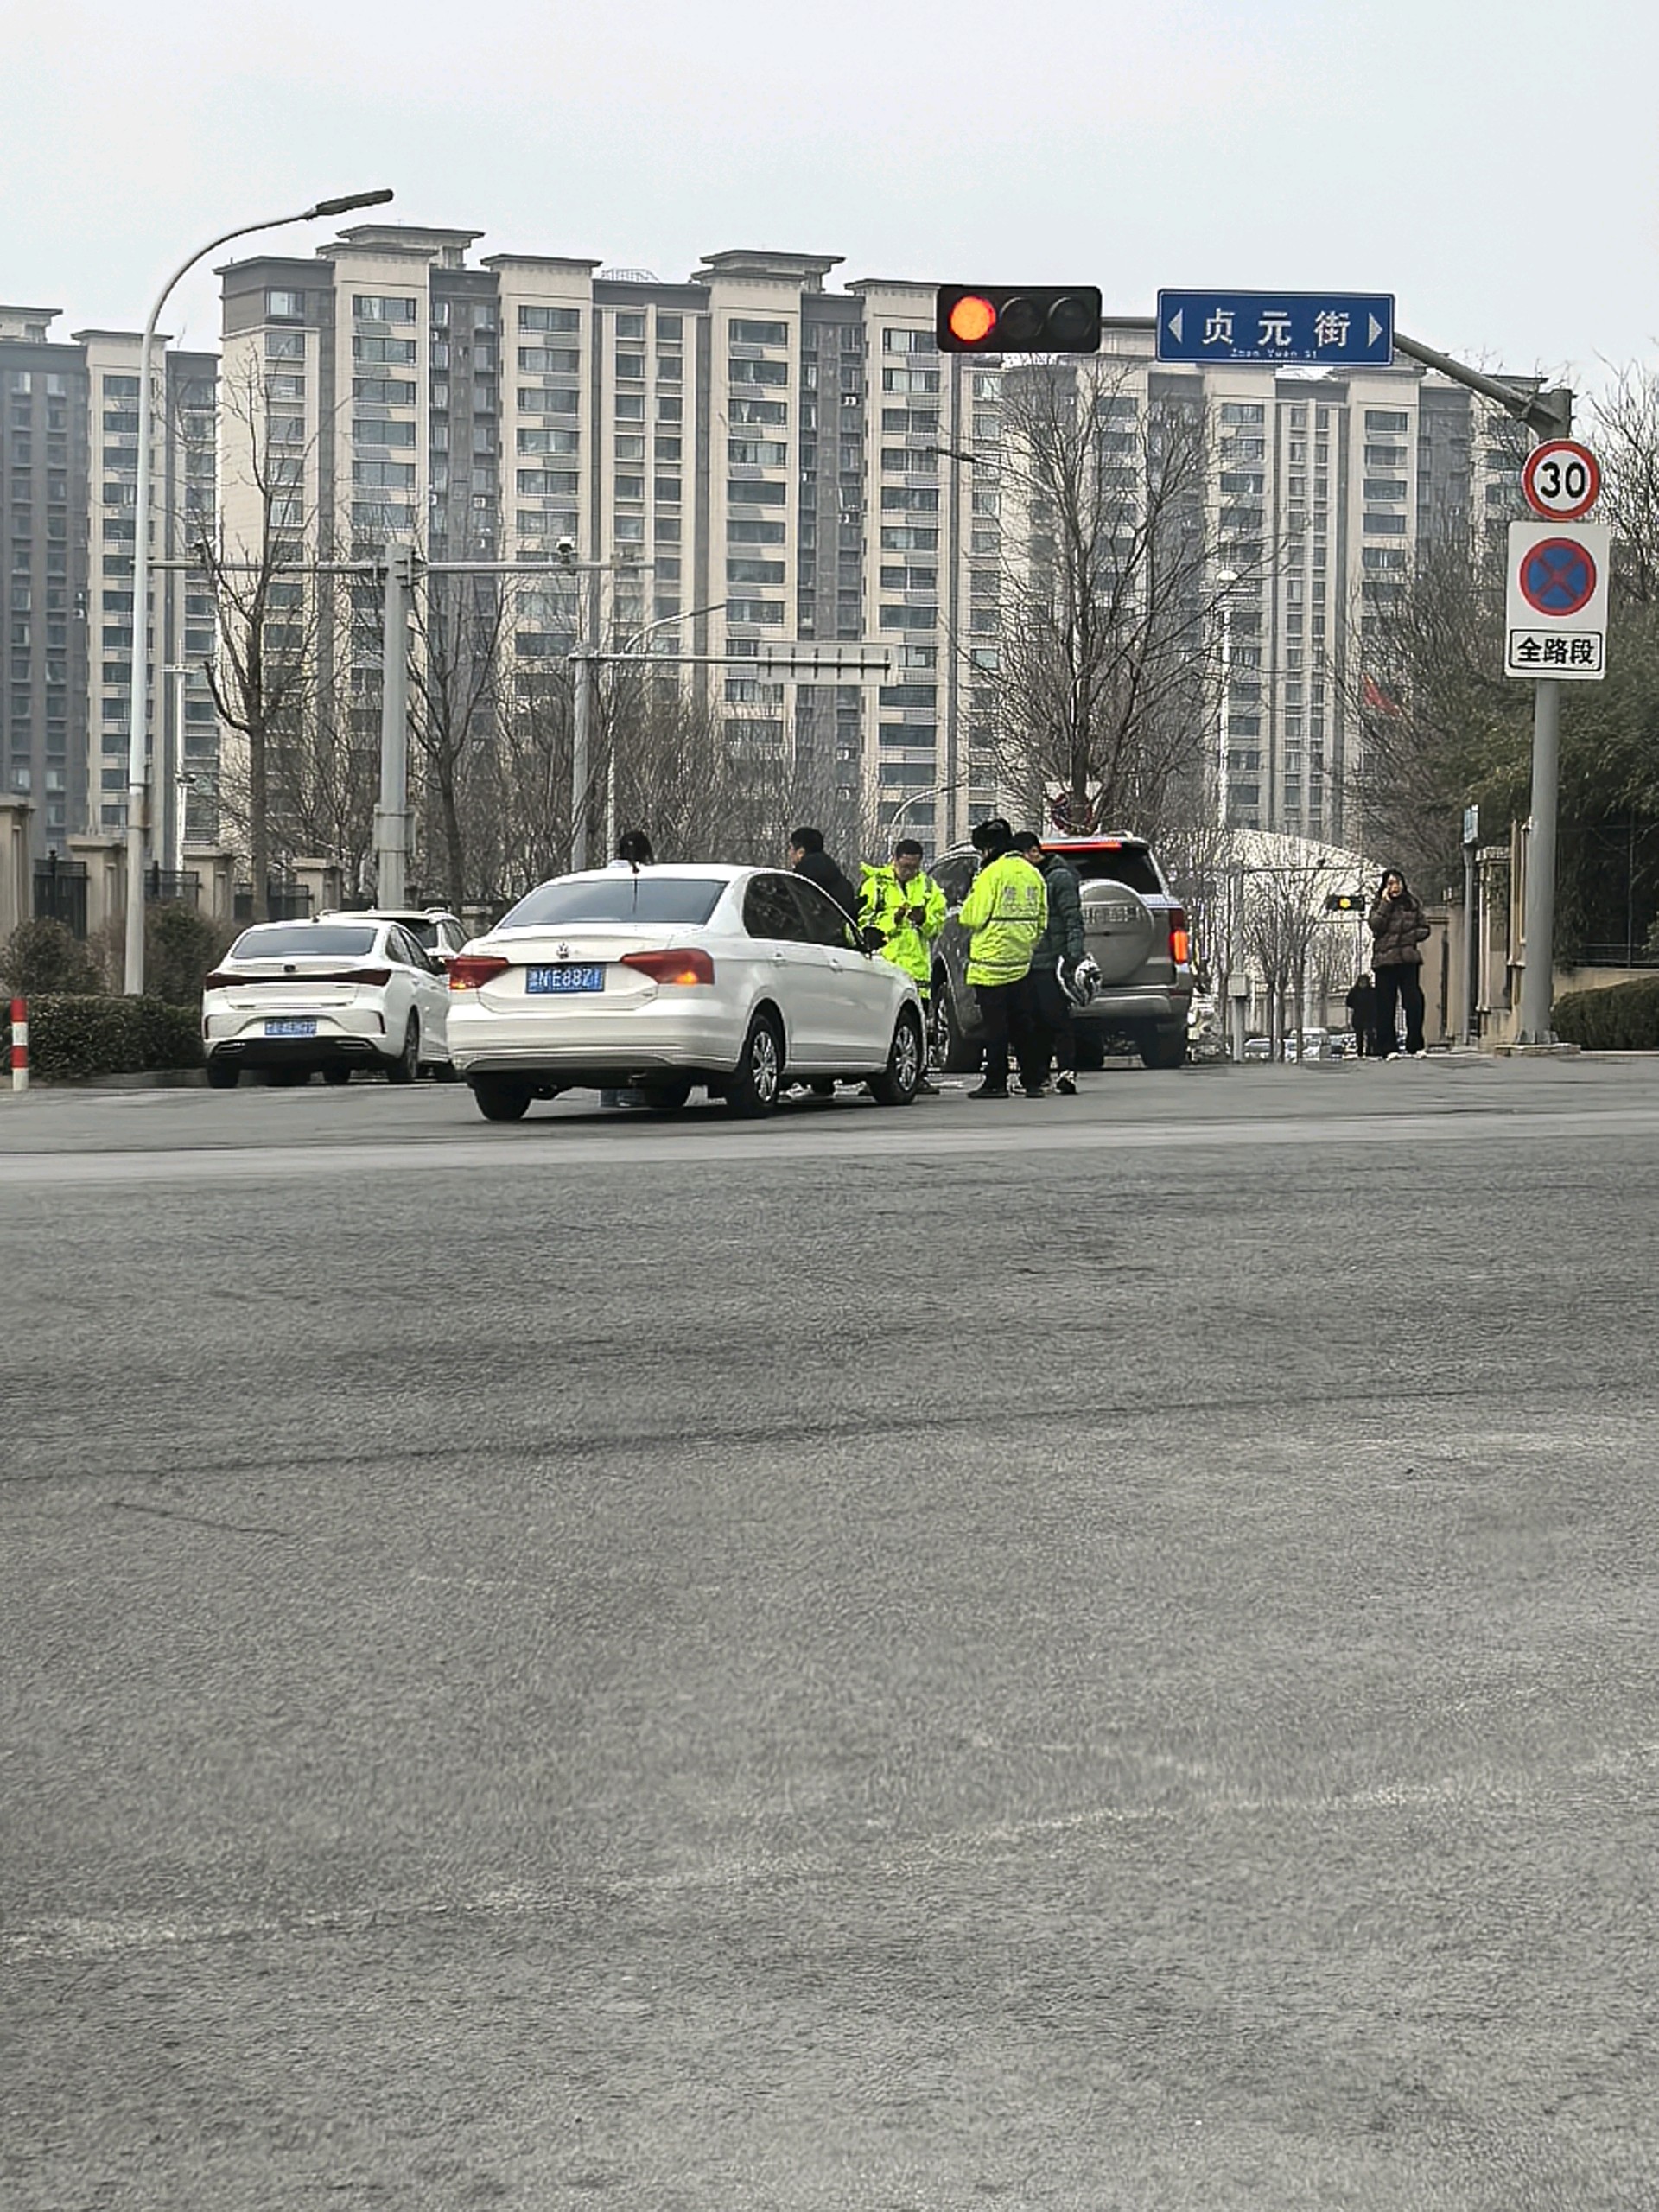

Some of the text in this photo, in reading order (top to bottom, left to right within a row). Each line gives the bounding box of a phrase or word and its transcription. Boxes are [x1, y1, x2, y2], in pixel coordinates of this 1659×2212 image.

[1202, 308, 1351, 347] 贞元街
[1541, 461, 1586, 499] 30
[1517, 636, 1595, 664] 全路段
